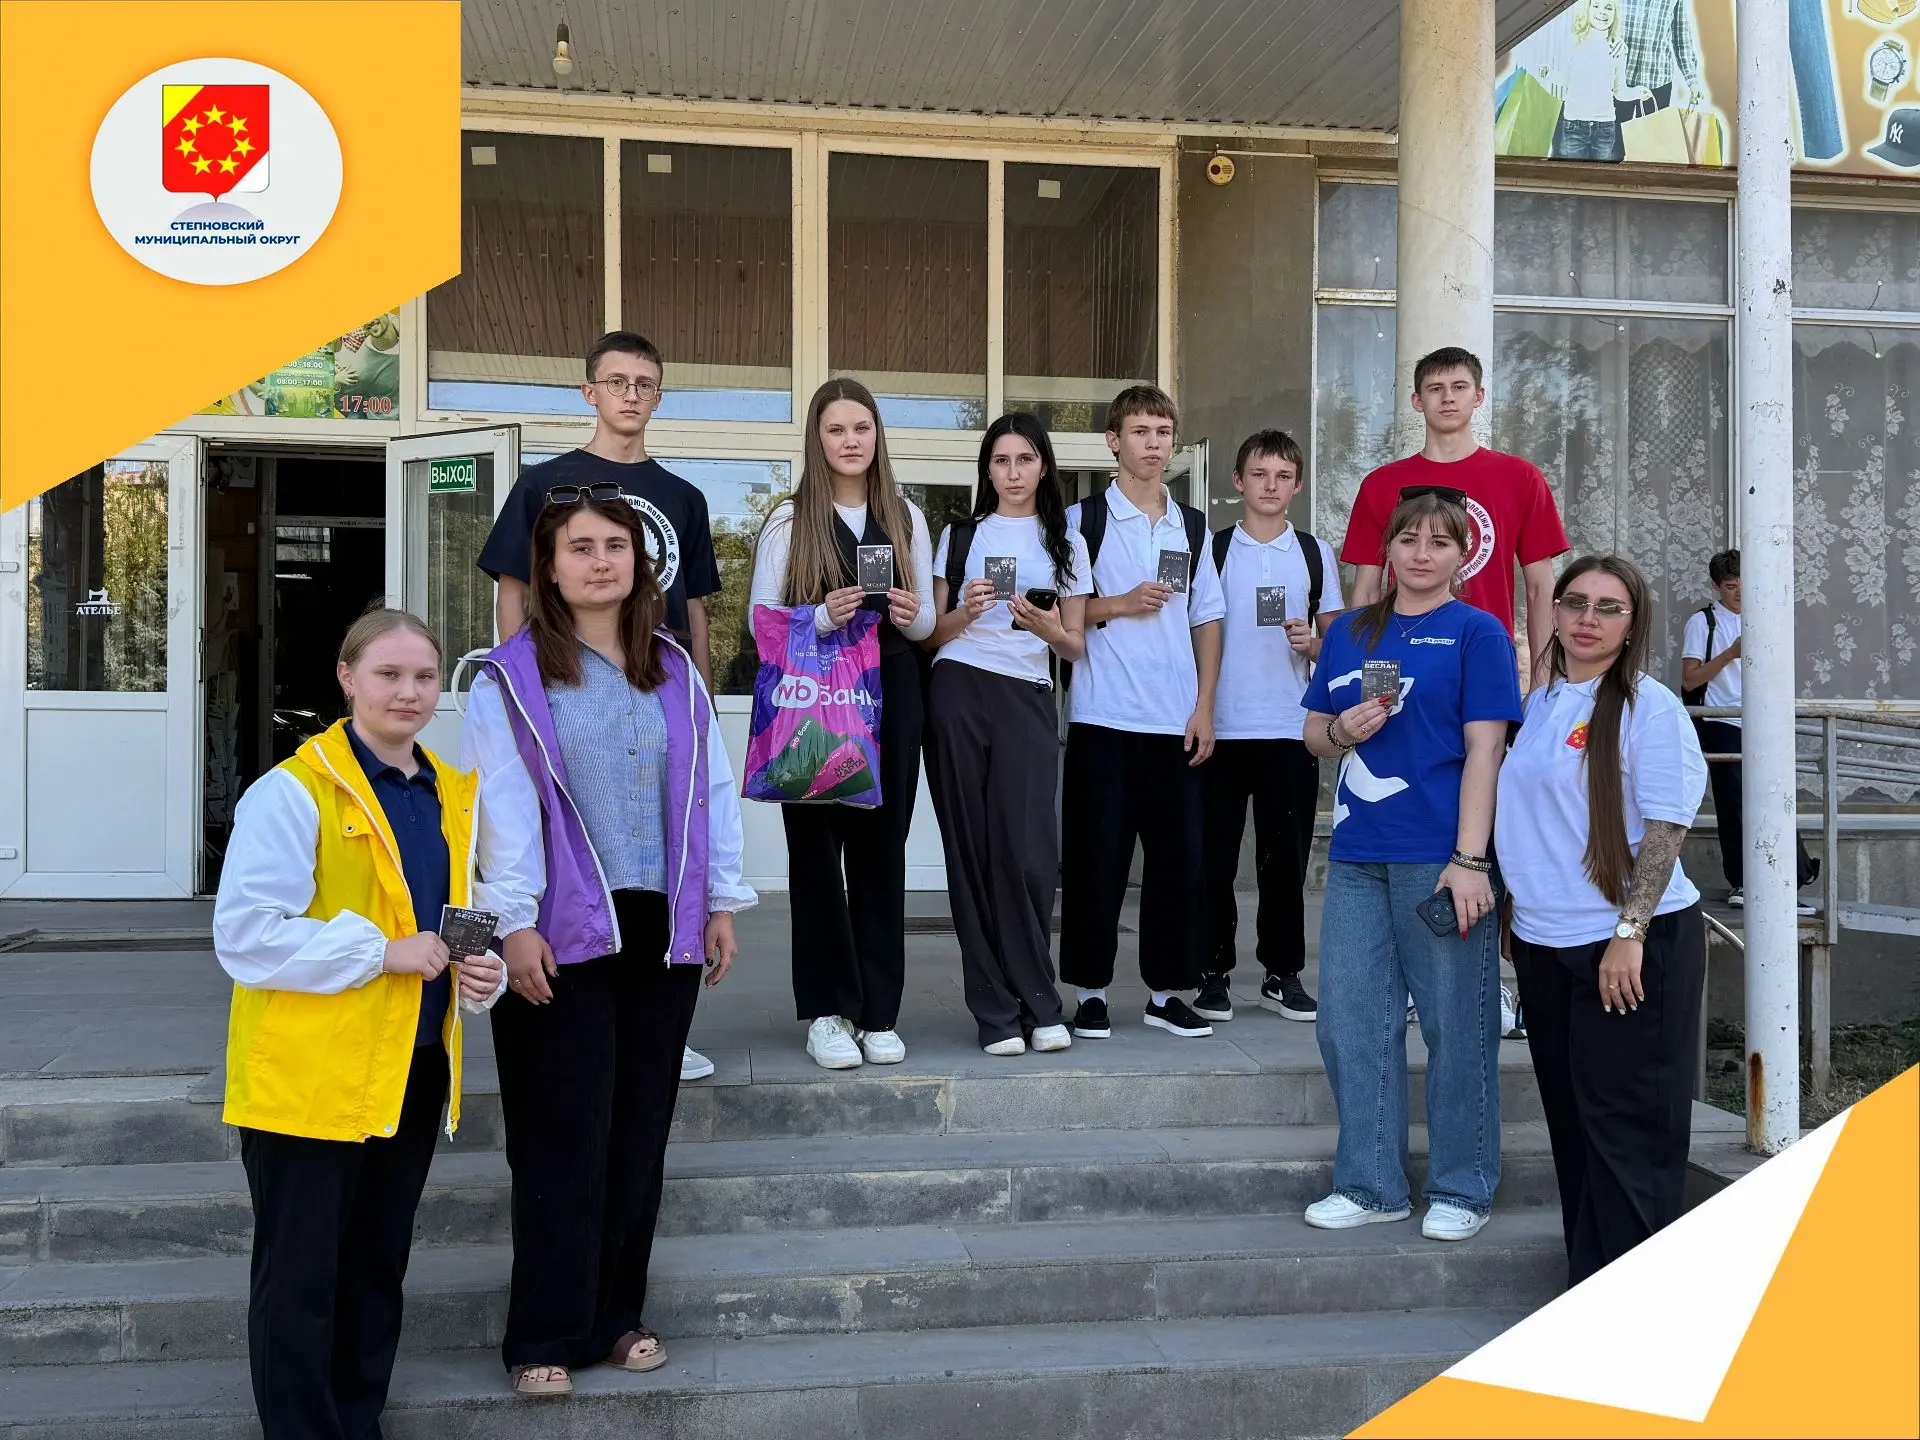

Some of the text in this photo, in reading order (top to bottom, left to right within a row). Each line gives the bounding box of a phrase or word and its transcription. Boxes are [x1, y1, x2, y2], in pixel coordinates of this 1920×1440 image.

[340, 395, 392, 414] 17:00
[431, 464, 473, 485] ВЫХОД
[76, 606, 122, 615] АТЕЛЬЕ
[778, 680, 812, 702] wb
[834, 756, 855, 773] МОЯ
[836, 758, 866, 780] КАРТА
[455, 912, 496, 926] БЕСЛАН
